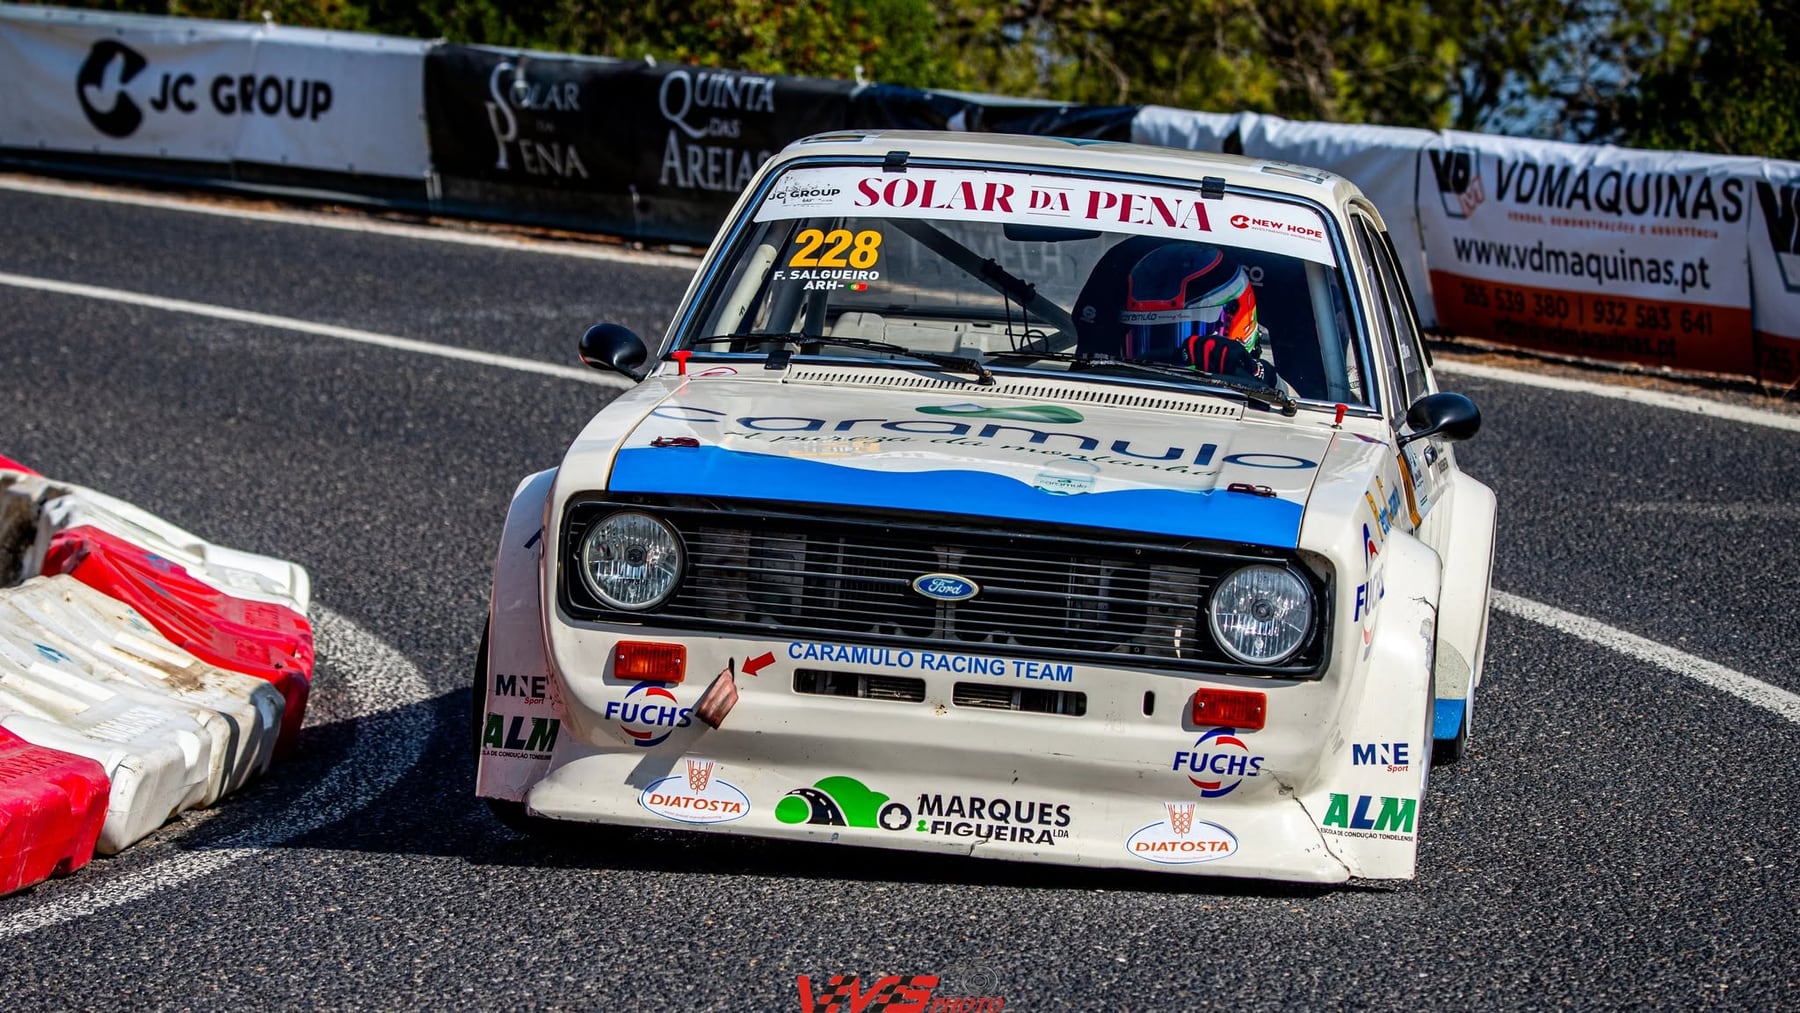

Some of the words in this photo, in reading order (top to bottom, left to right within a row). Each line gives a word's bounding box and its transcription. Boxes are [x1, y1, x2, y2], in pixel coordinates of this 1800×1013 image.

[150, 73, 197, 113] JC
[210, 74, 333, 121] GROUP
[659, 70, 776, 138] QUINTA
[485, 100, 590, 178] PENA
[707, 117, 741, 138] DAS
[768, 192, 786, 200] JC
[790, 189, 840, 198] GROUP
[854, 178, 1014, 213] SOLAR
[1029, 190, 1070, 211] DA
[1085, 190, 1212, 232] PENA
[1496, 156, 1744, 223] VDMAQUINAS
[1252, 218, 1283, 229] NEW
[1287, 225, 1322, 238] HOPE
[788, 229, 882, 269] 228
[1453, 236, 1711, 293] www.vdmaquinas.pt
[773, 271, 786, 280] F.
[790, 270, 879, 281] SALGUEIRO
[1495, 288, 1525, 314] 539
[1533, 292, 1569, 319] 380
[1593, 301, 1627, 327] 932
[1636, 306, 1671, 331] 583
[1680, 308, 1712, 335] 641
[929, 437, 986, 447] da
[1001, 443, 1223, 476] montanha
[928, 578, 963, 595] Ford
[788, 642, 913, 668] CARAMULO
[920, 652, 1005, 676] RACING
[1012, 660, 1073, 683] TEAM
[524, 697, 545, 705] Sport
[605, 701, 693, 728] FUCHS
[482, 712, 560, 752] ALM
[1172, 751, 1264, 777] FUCHS
[1387, 765, 1408, 773] Sport
[649, 793, 741, 813] DIATOSTA
[917, 793, 1071, 828] MARQUES
[1322, 793, 1417, 833] ALM
[930, 820, 1055, 846] FIGUEIRA
[1053, 828, 1069, 839] LDA
[1135, 841, 1229, 852] DIATOSTA
[1344, 831, 1377, 839] CONDUÇÃO
